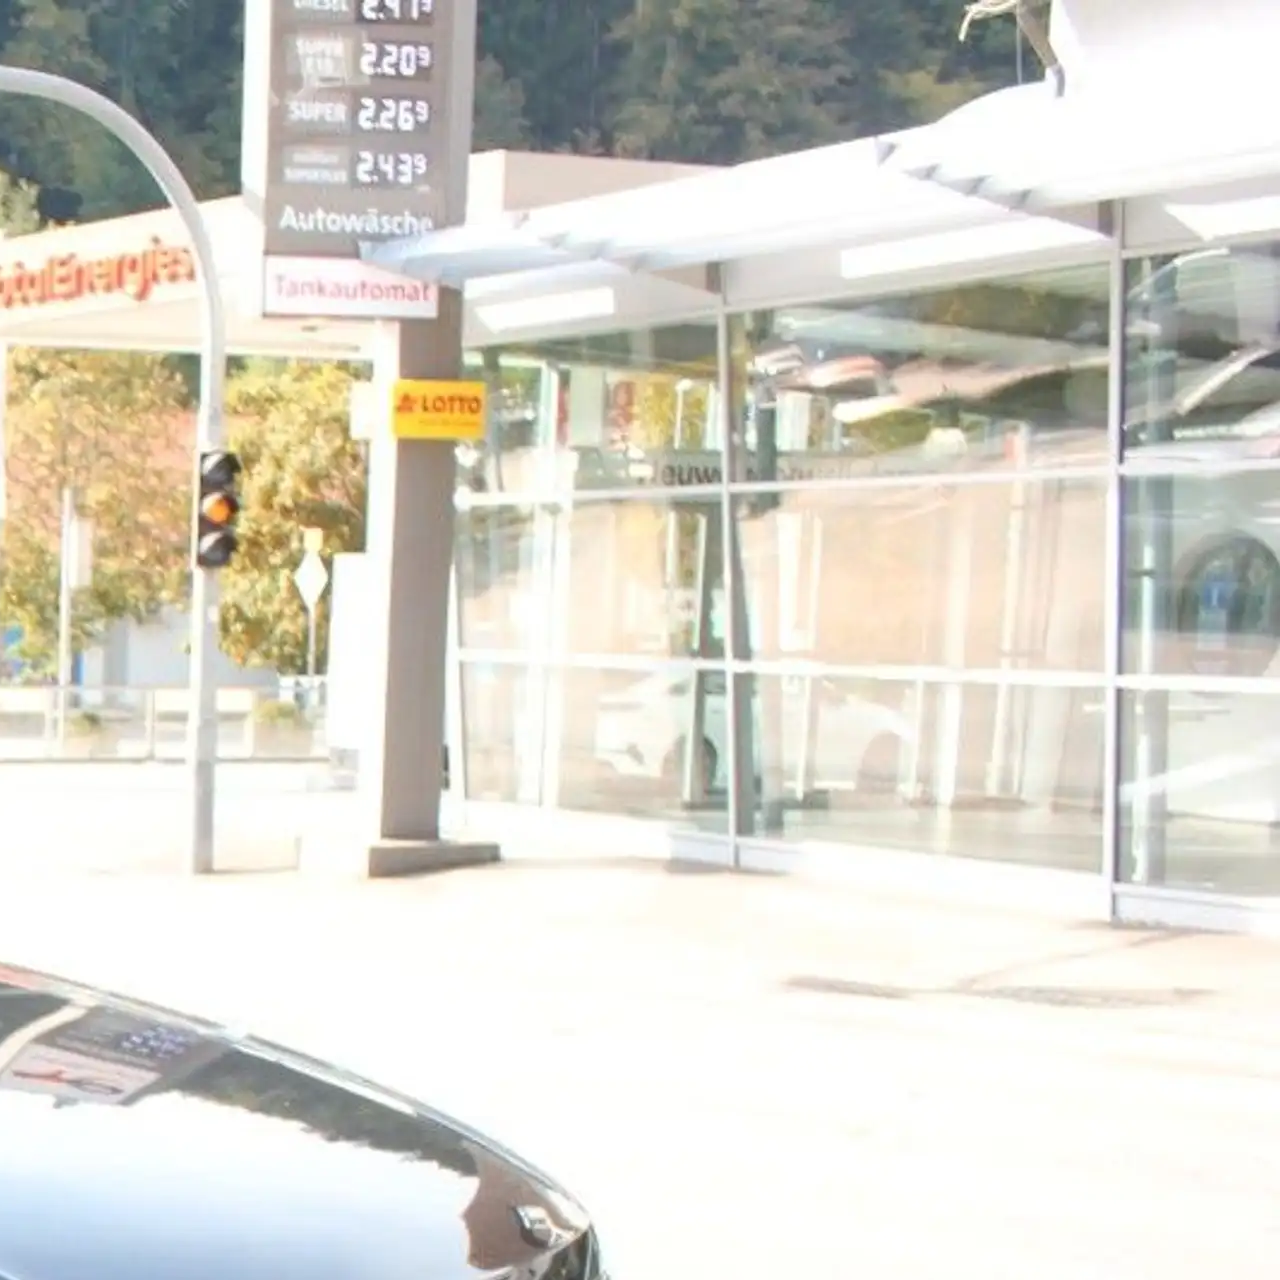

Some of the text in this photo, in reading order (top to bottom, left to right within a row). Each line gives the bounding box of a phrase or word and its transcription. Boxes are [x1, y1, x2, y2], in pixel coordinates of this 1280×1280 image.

[278, 204, 434, 236] Autowäsche
[274, 273, 431, 302] Tankautomat
[421, 395, 482, 414] LOTTO
